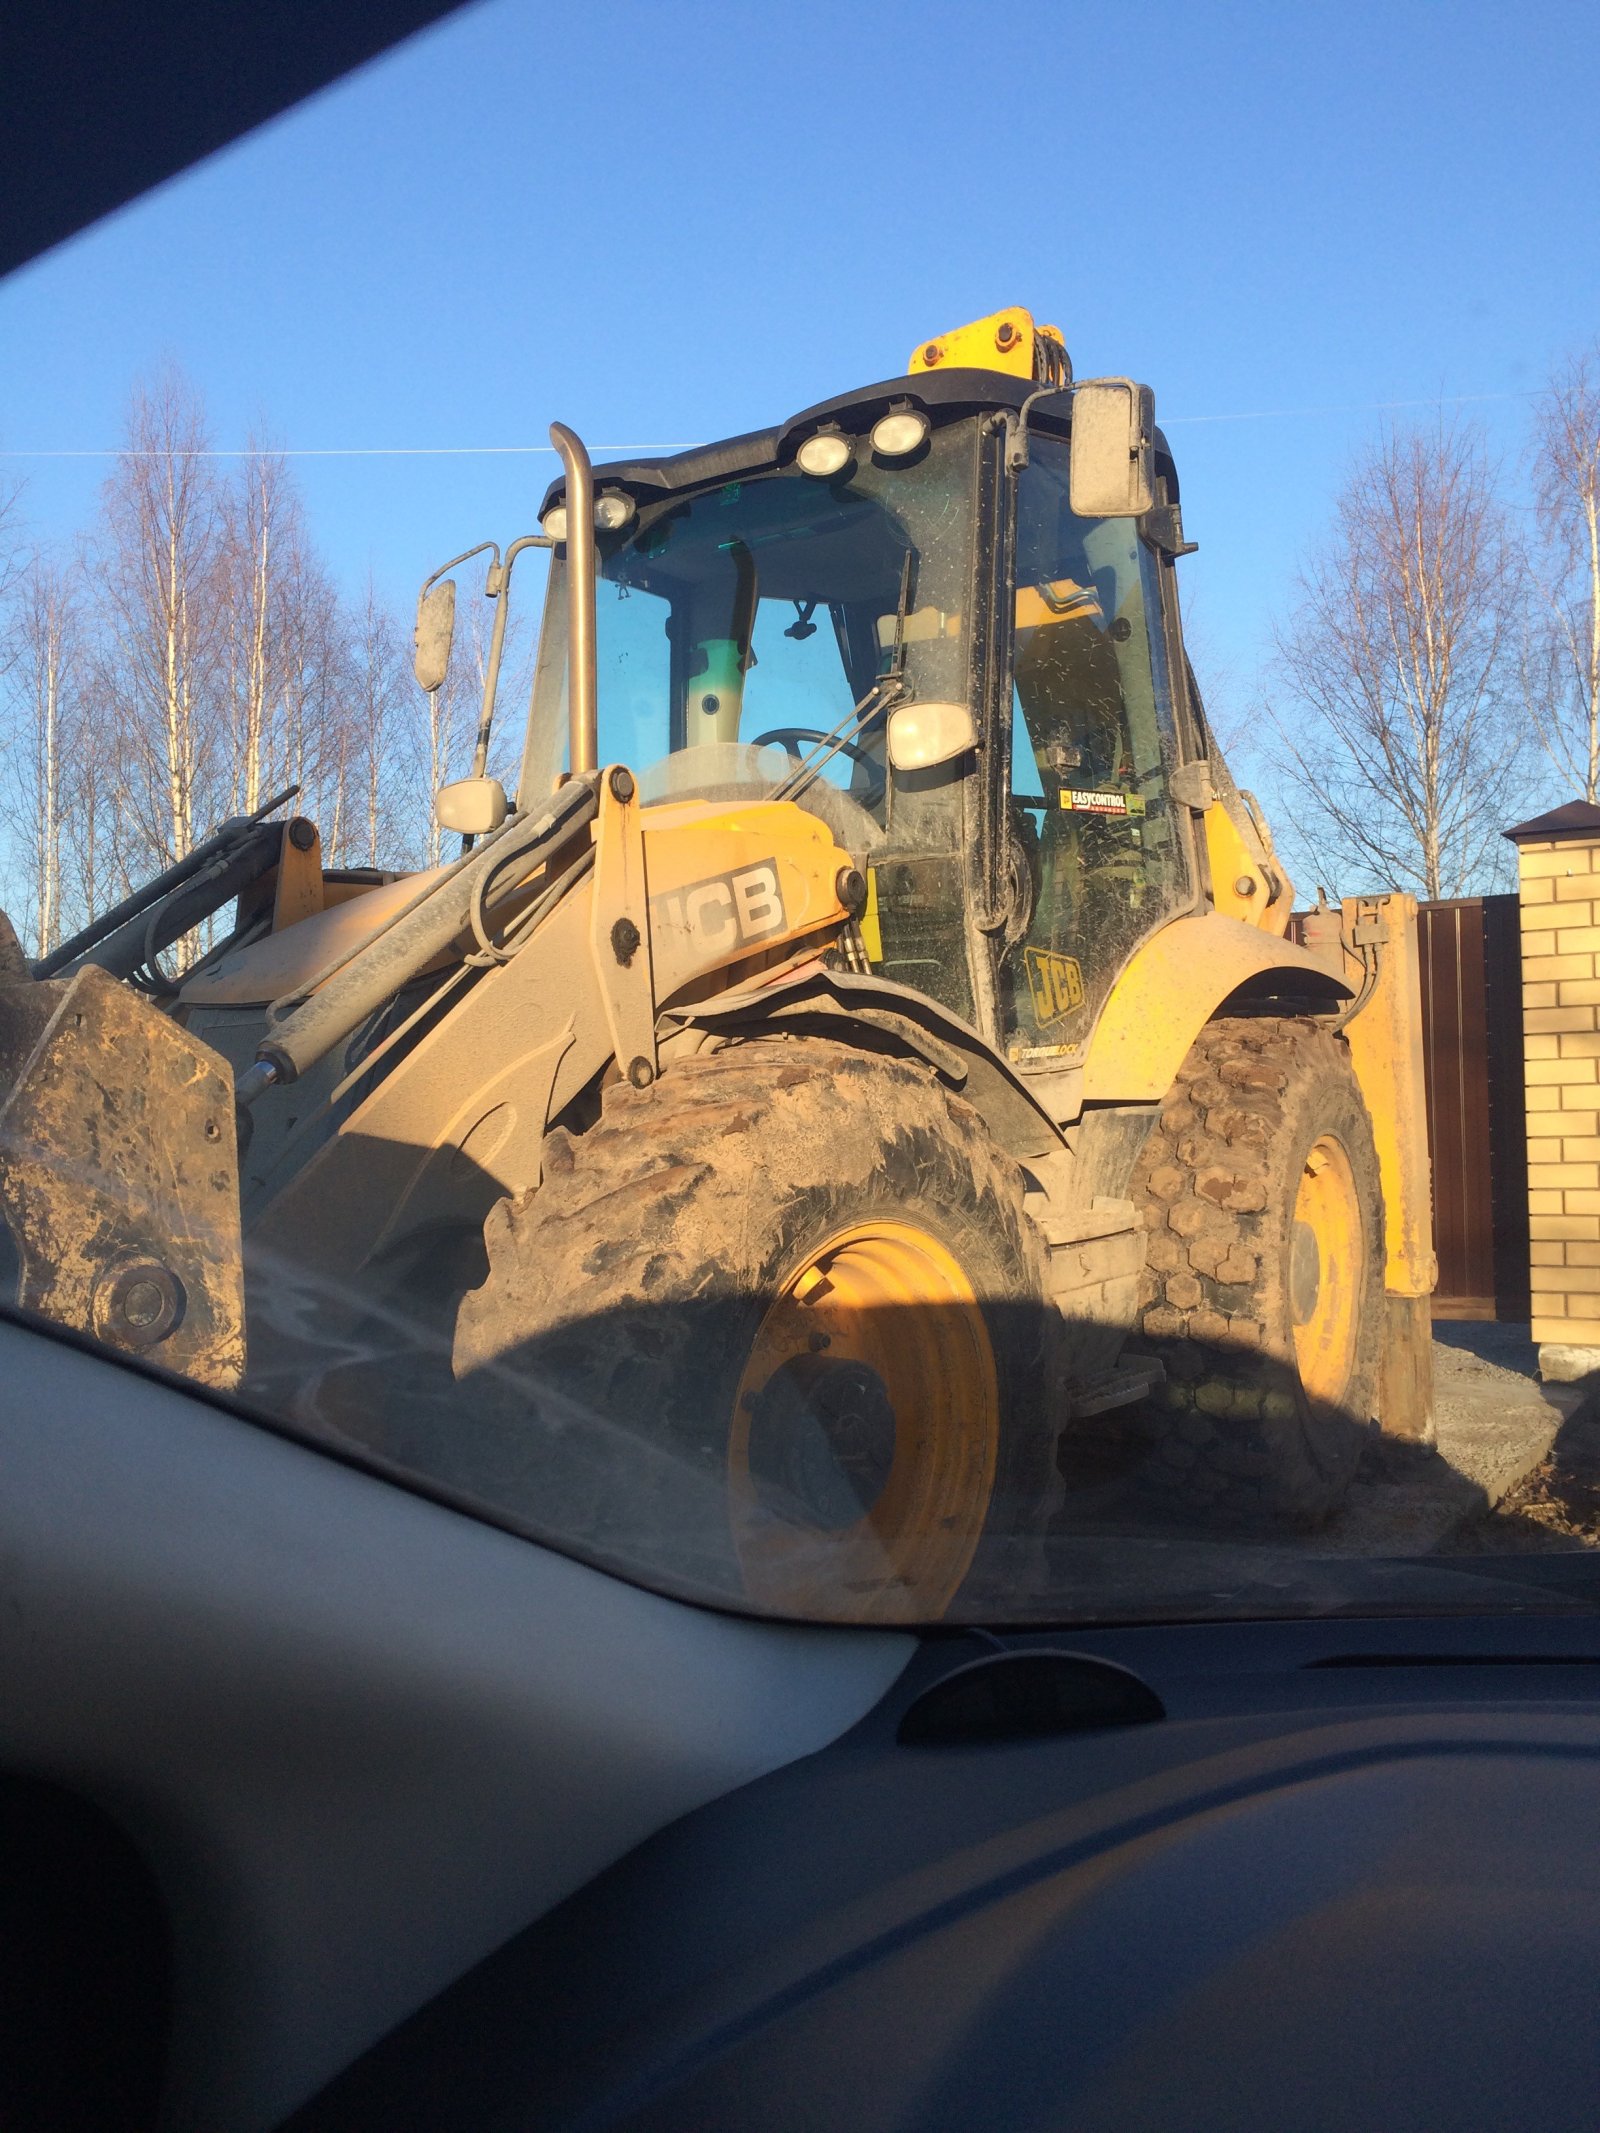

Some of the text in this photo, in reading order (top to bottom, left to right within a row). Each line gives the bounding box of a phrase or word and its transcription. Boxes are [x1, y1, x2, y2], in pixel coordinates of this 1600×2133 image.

[1072, 791, 1126, 808] EASYCONTROL
[1036, 956, 1081, 1019] JCB
[1021, 1043, 1079, 1059] TORQUELOCK
